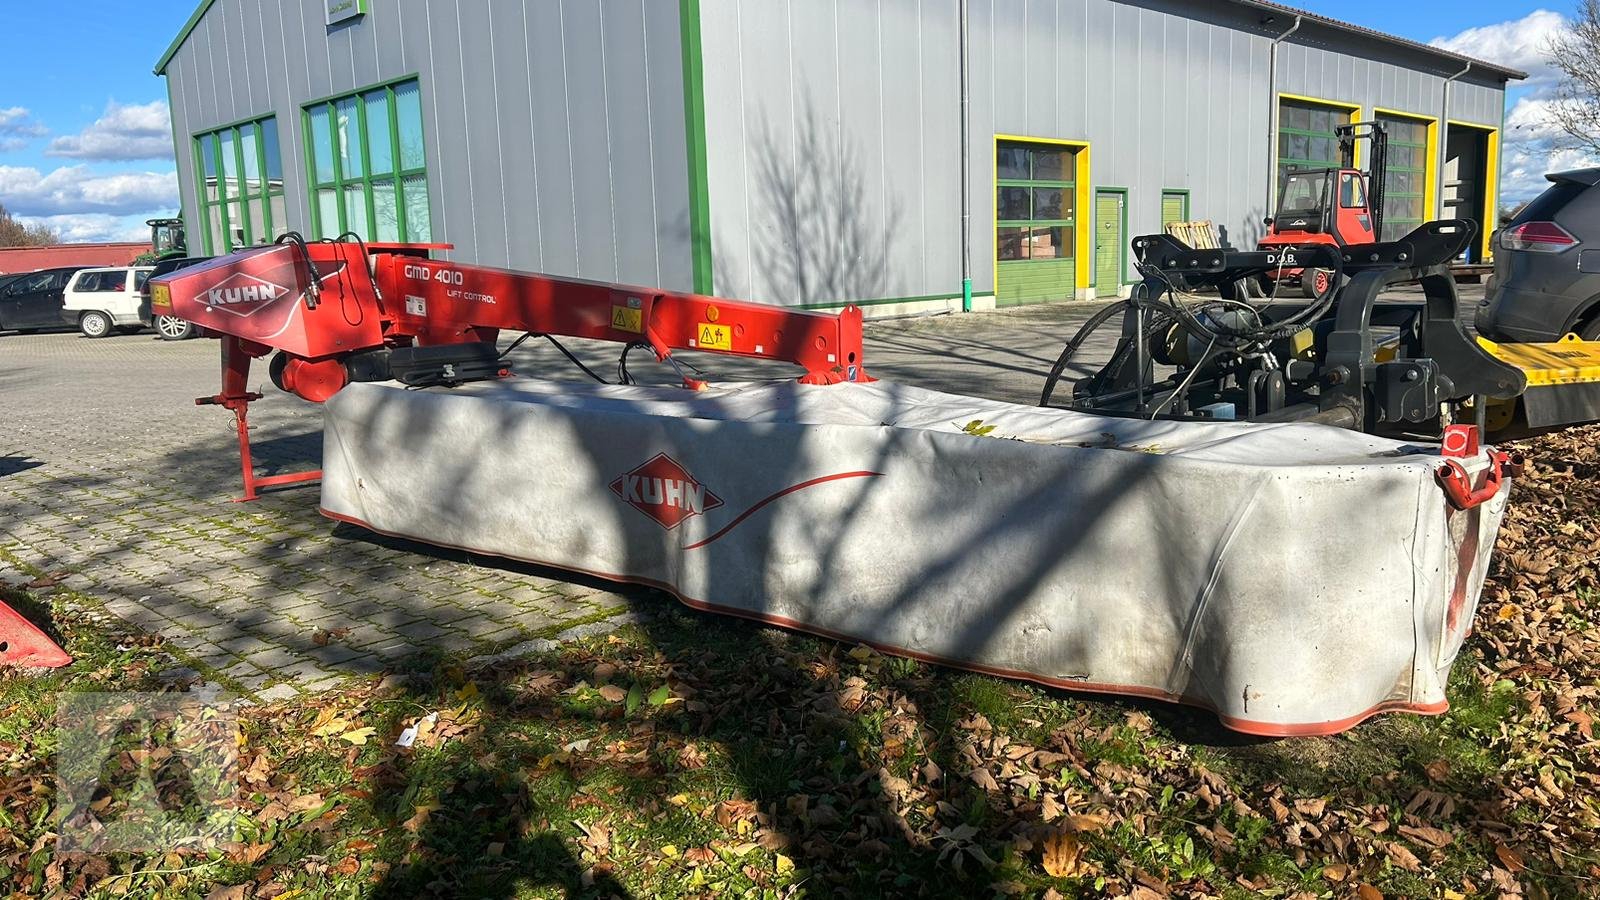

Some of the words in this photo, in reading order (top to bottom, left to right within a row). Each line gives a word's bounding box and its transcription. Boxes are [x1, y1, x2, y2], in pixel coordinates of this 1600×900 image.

[404, 265, 430, 280] GMD
[434, 269, 463, 286] 4010
[208, 283, 276, 306] KUHN
[447, 289, 462, 299] LIFT
[464, 291, 497, 305] CONTROL
[623, 474, 706, 515] KUHN
